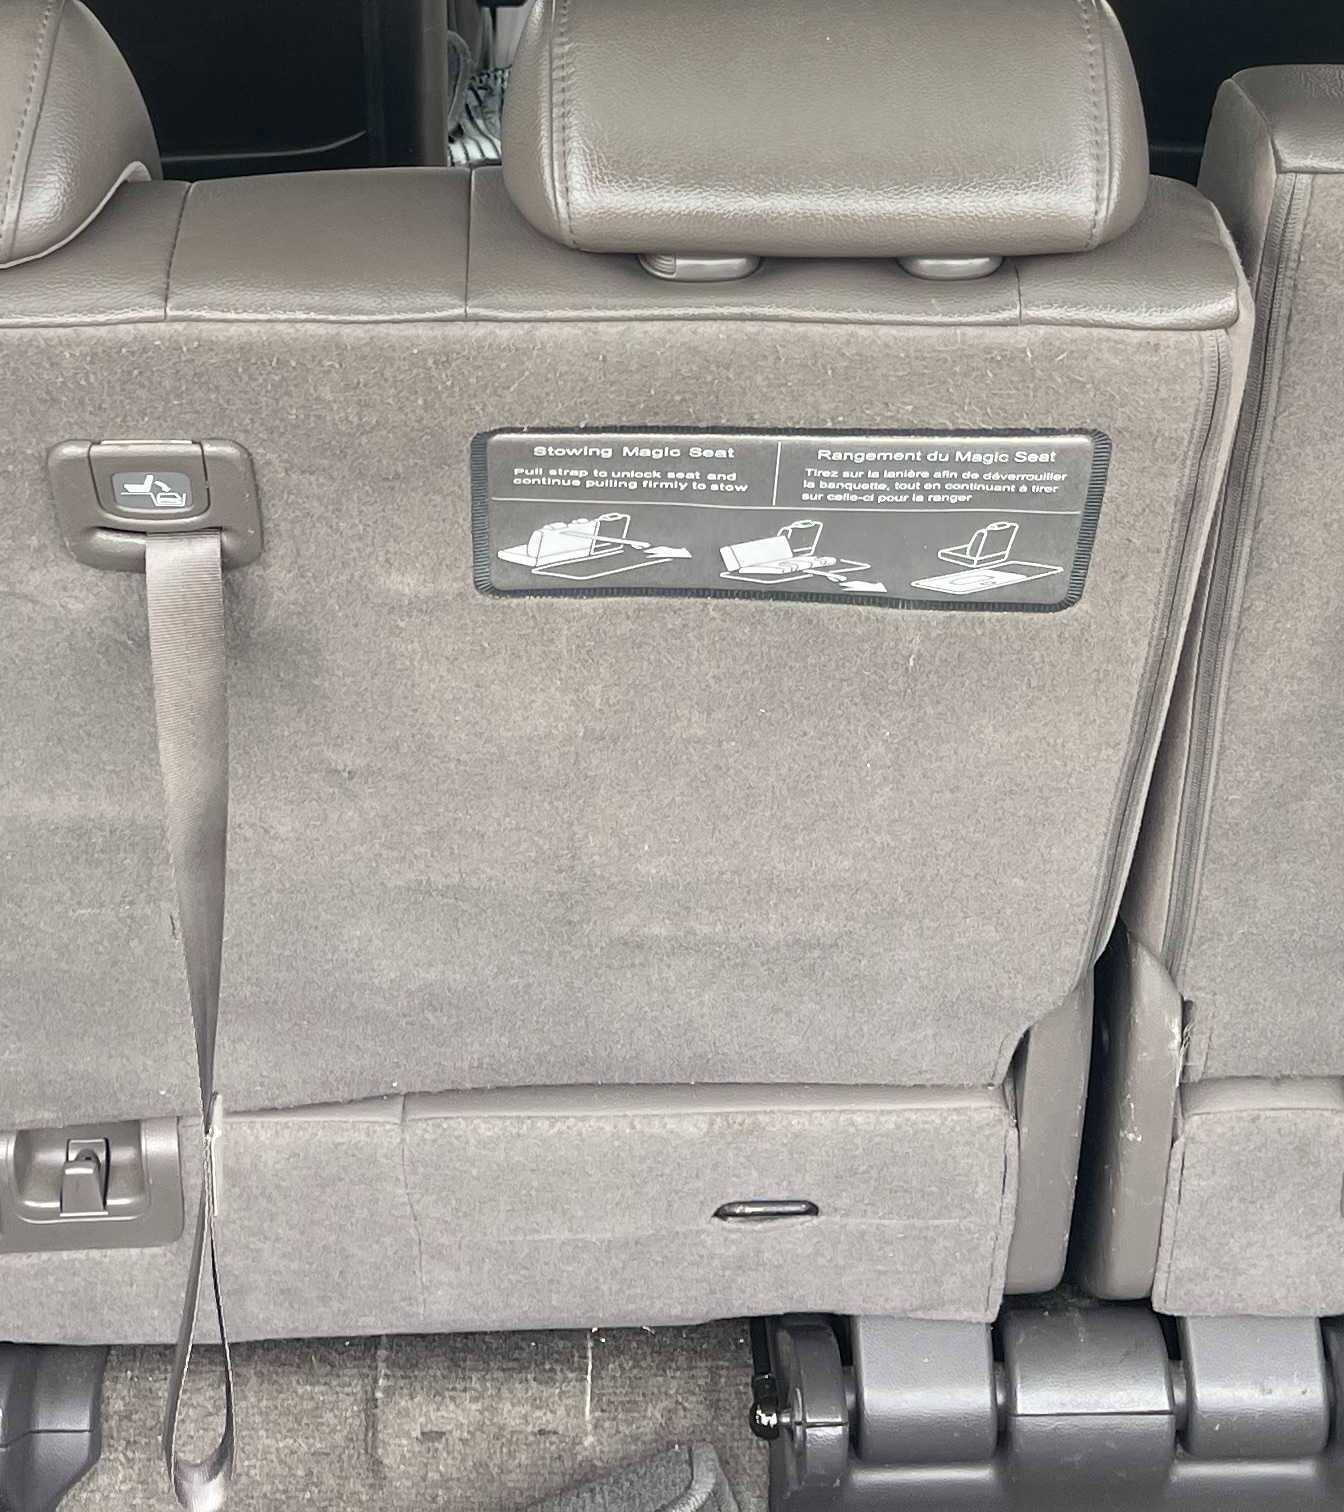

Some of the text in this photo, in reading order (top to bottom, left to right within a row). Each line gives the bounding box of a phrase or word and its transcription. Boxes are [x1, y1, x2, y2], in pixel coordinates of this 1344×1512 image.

[533, 446, 735, 459] Stowing Magic Seat
[818, 450, 1056, 464] Rangement du Magic Seat
[514, 468, 736, 481] Pull strap to unlock seat and
[806, 469, 1067, 481] Tirez sur la lanière afin de déverrouiller
[514, 477, 748, 492] continue pulling firmly to stow
[804, 479, 815, 489] la
[895, 481, 920, 490] tout
[924, 482, 941, 490] en
[945, 481, 1015, 492] continuant
[1032, 484, 1059, 493] tirer
[802, 492, 972, 504] sur celle-ci pour la ranger
